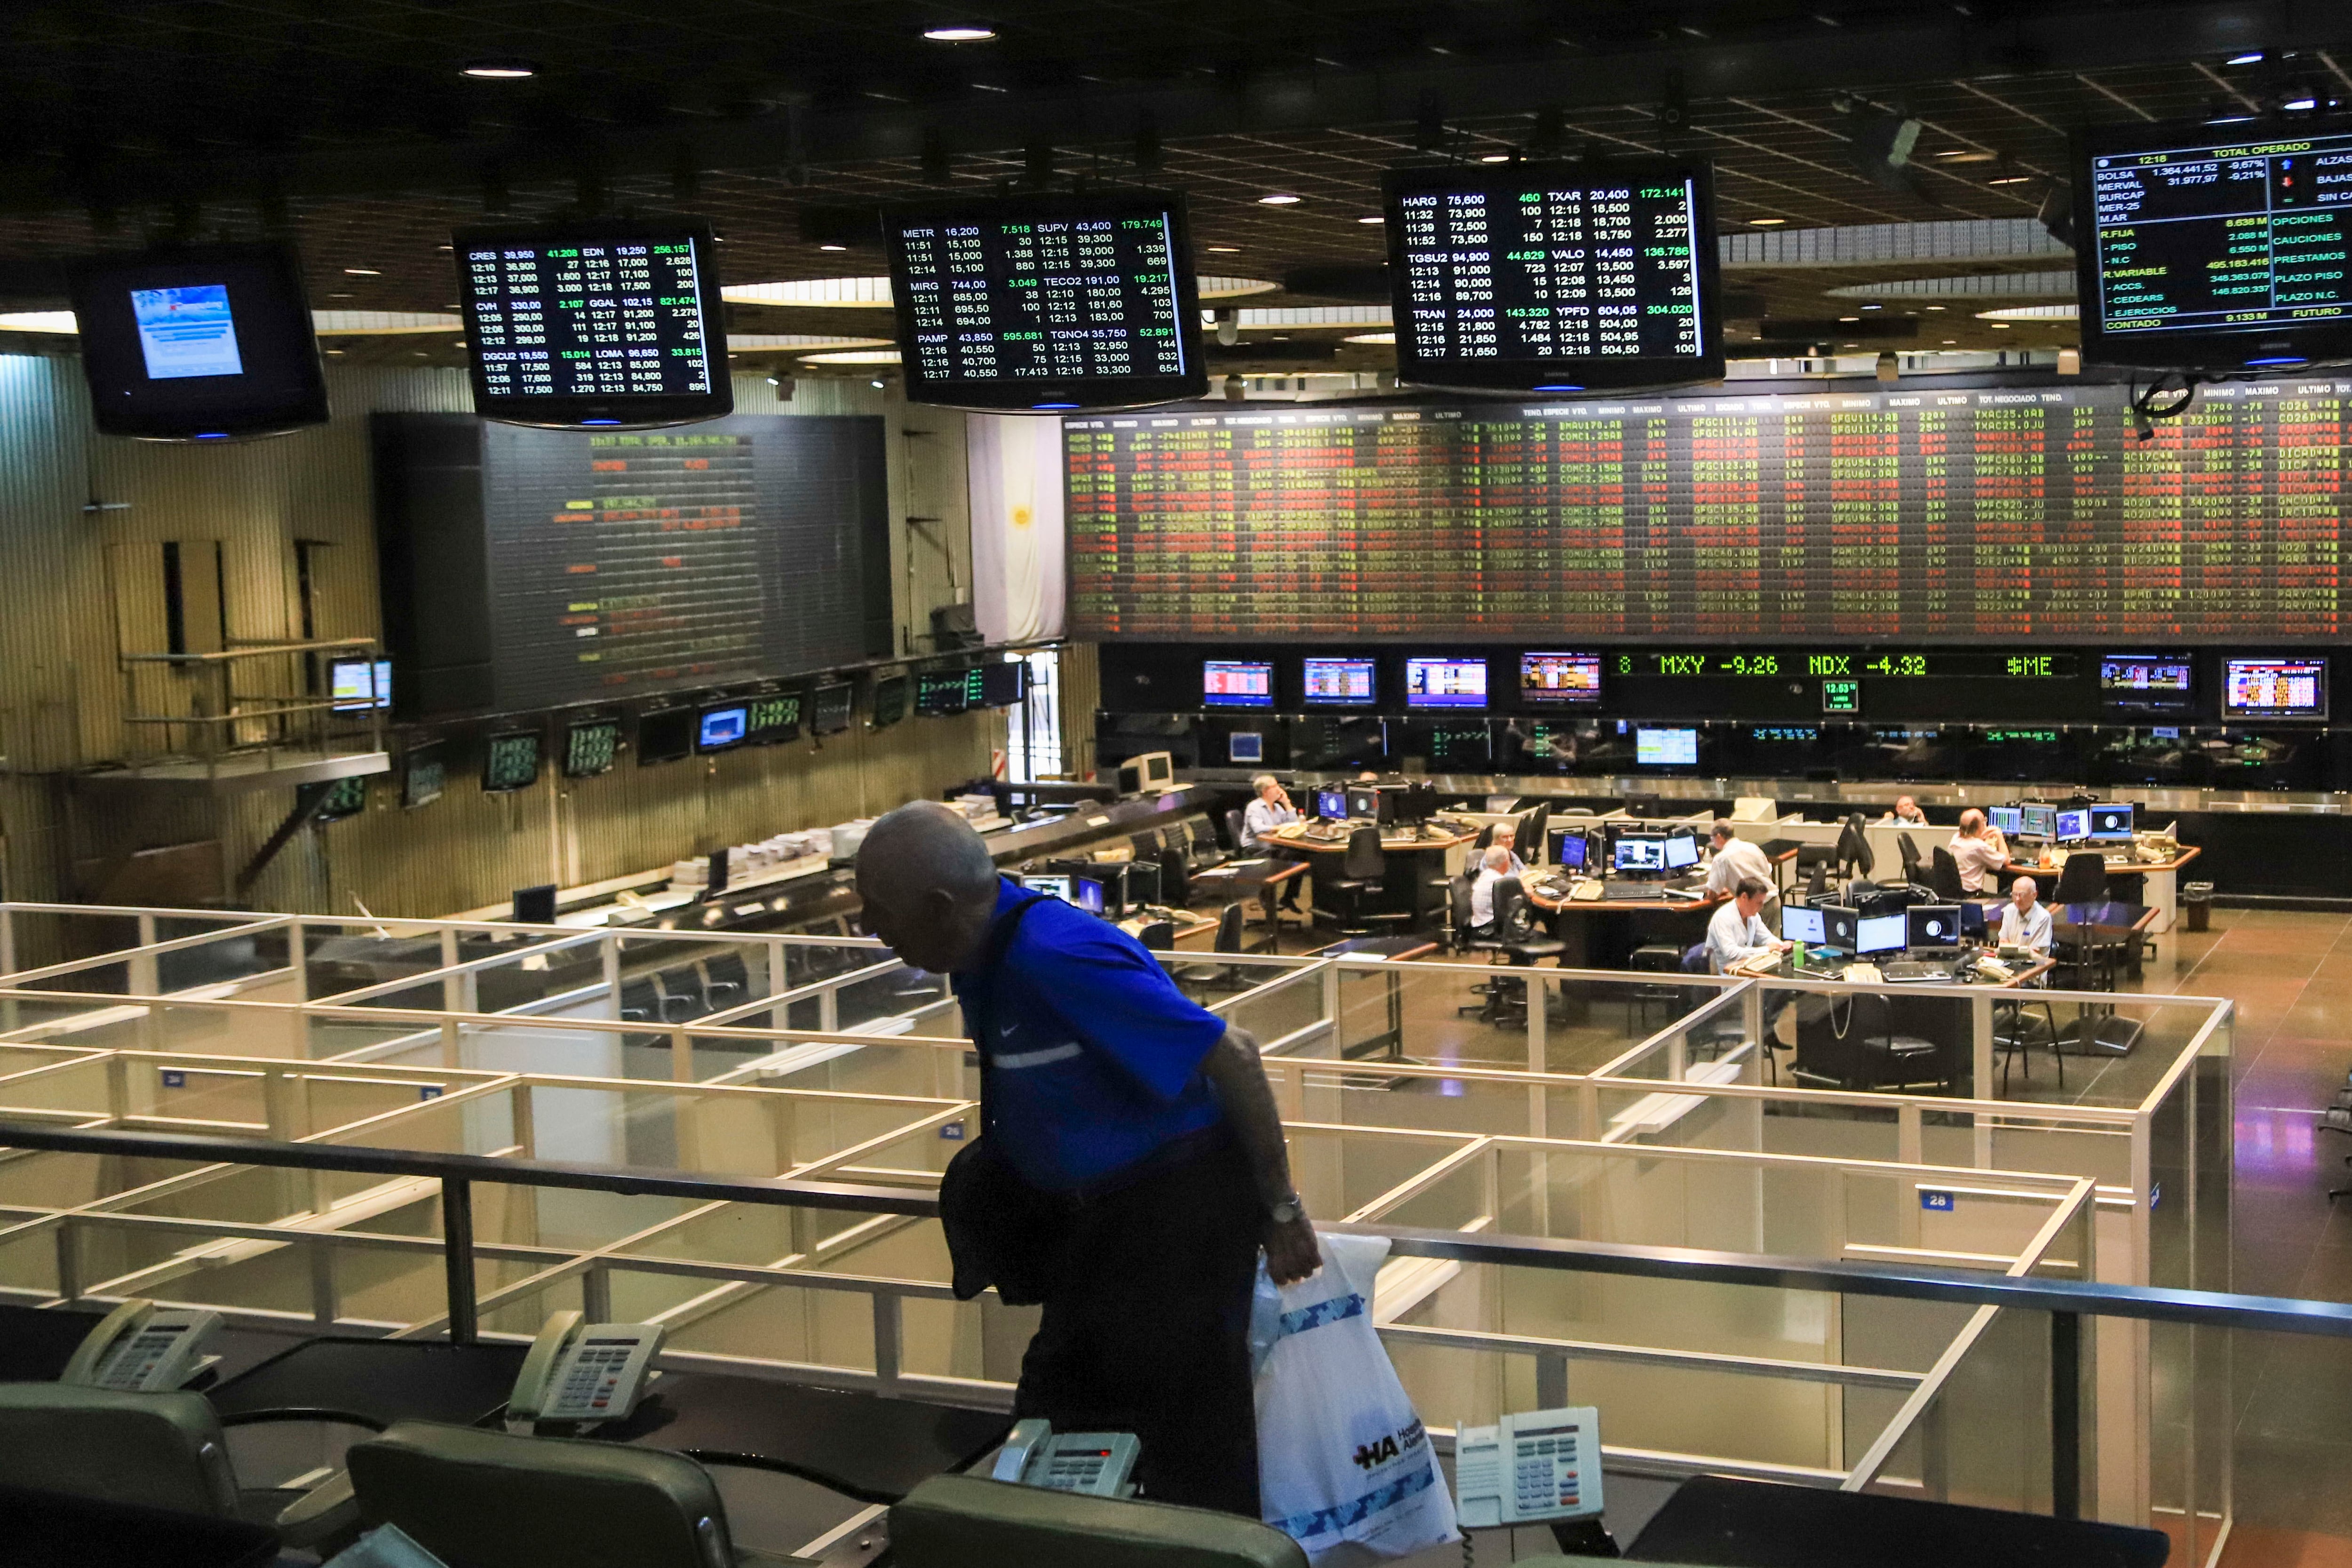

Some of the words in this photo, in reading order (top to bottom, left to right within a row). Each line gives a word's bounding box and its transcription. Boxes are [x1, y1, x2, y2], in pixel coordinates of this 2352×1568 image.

[2212, 148, 2249, 158] TOTAL
[2252, 143, 2311, 154] OPERADO
[2138, 155, 2167, 164] 12:18
[2098, 171, 2134, 181] BOLSA
[2153, 164, 2218, 176] 1.364.441,52
[2228, 160, 2265, 170] -9,67%
[2098, 181, 2143, 191] MERVAL
[2167, 175, 2218, 186] 31.977,97
[2227, 171, 2265, 181] -9,21%
[1403, 197, 1437, 207] HARG
[1446, 194, 1485, 206] 75,600
[1519, 193, 1541, 202] 460
[1547, 191, 1581, 201] TXAR
[1589, 189, 1630, 201] 20,400
[1640, 188, 1684, 198] 172.141
[2098, 191, 2145, 202] BURCAP
[2317, 192, 2338, 202] SIN
[1405, 210, 1434, 220] 11:32
[1448, 208, 1486, 219] 73,900
[1521, 206, 1542, 216] 100
[1549, 204, 1581, 215] 12:15
[1591, 203, 1630, 214] 18,500
[1678, 201, 1685, 210] 2
[2099, 202, 2140, 213] MER-25
[2099, 214, 2127, 223] M.AR
[2272, 214, 2334, 226] OPCIONES
[903, 229, 935, 238] METR
[945, 227, 979, 237] 16,200
[1001, 225, 1031, 234] 7.518
[1037, 223, 1069, 232] SUPV
[1076, 222, 1111, 232] 43,400
[1121, 219, 1162, 229] 179.749
[2100, 229, 2135, 239] R.FIJA
[2225, 219, 2255, 227] 8.638
[905, 241, 931, 250] 11:51
[946, 239, 981, 249] 15,100
[1019, 237, 1032, 246] 30
[1040, 236, 1067, 245] 12:15
[1077, 234, 1112, 244] 39,300
[2273, 233, 2342, 245] CAUCIONES
[582, 247, 604, 257] EDN
[616, 246, 647, 256] 19,250
[653, 245, 689, 254] 256.157
[1551, 249, 1585, 259] VALO
[1595, 247, 1633, 259] 14,450
[1644, 246, 1688, 257] 136.786
[2110, 243, 2137, 251] PISO
[469, 252, 497, 261] CRES
[503, 250, 535, 260] 39,950
[547, 249, 578, 258] 41.208
[1407, 253, 1448, 263] TGSU2
[1452, 252, 1490, 263] 94,900
[1507, 251, 1545, 261] 44.629
[2274, 252, 2346, 264] PRESTAMOS
[2103, 267, 2168, 279] R.VARIABLE
[2275, 273, 2312, 284] PLAZO
[2315, 271, 2343, 280] PISO
[910, 282, 939, 291] MIRG
[951, 280, 986, 290] 744,00
[1009, 279, 1037, 287] 3.049
[1043, 277, 1082, 287] TECO2
[1085, 275, 1120, 285] 191,00
[1134, 274, 1168, 283] 19.217
[1046, 289, 1074, 298] 12:10
[1087, 287, 1121, 297] 180,00
[1141, 286, 1170, 295] 4.295
[2113, 283, 2145, 291] ACCS.
[589, 299, 618, 308] GGAL
[622, 297, 653, 307] 102,15
[660, 296, 696, 305] 821.474
[913, 294, 938, 302] 12:11
[953, 292, 988, 302] 685,00
[1025, 291, 1039, 299] 38
[2113, 294, 2164, 304] CEDEARS
[2276, 292, 2313, 302] PLAZO
[2315, 290, 2339, 300] N.C.
[476, 302, 498, 311] CVH
[510, 301, 541, 310] 330,00
[559, 300, 584, 309] 2.107
[1556, 306, 1589, 316] YPFD
[1597, 305, 1638, 316] 604,05
[1646, 304, 1692, 314] 304.020
[2114, 306, 2177, 317] EJERCICIOS
[1413, 310, 1446, 319] TRAN
[1457, 308, 1494, 319] 24,000
[1505, 308, 1549, 317] 143.320
[2293, 308, 2342, 318] FUTURO
[2106, 319, 2161, 330] CONTADO
[2225, 313, 2255, 322] 9.133
[918, 334, 948, 343] PAMP
[959, 333, 993, 342] 43,850
[1003, 332, 1042, 341] 595.681
[1050, 330, 1089, 339] TGNO4
[1091, 329, 1127, 339] 35,750
[1140, 327, 1173, 336] 52.891
[482, 352, 517, 361] DGCU2
[518, 351, 549, 360] 19,550
[561, 350, 591, 359] 15.014
[595, 350, 625, 358] LOMA
[628, 348, 659, 358] 96,650
[671, 348, 702, 356] 33.815
[2203, 388, 2234, 397] MINIMO
[2245, 387, 2279, 396] MAXIMO
[2298, 385, 2331, 394] ULTIMO
[1842, 399, 1871, 408] MINIMO
[1889, 398, 1920, 406] MAXIMO
[1937, 396, 1967, 406] ULTIMO
[1994, 394, 2036, 404] NEGOCIADO
[1633, 405, 1662, 414] MAXIMO
[1660, 655, 1705, 675] MXY
[1808, 655, 1850, 675] NDX
[2007, 656, 2052, 676] $ME
[1930, 1195, 1947, 1207] 28
